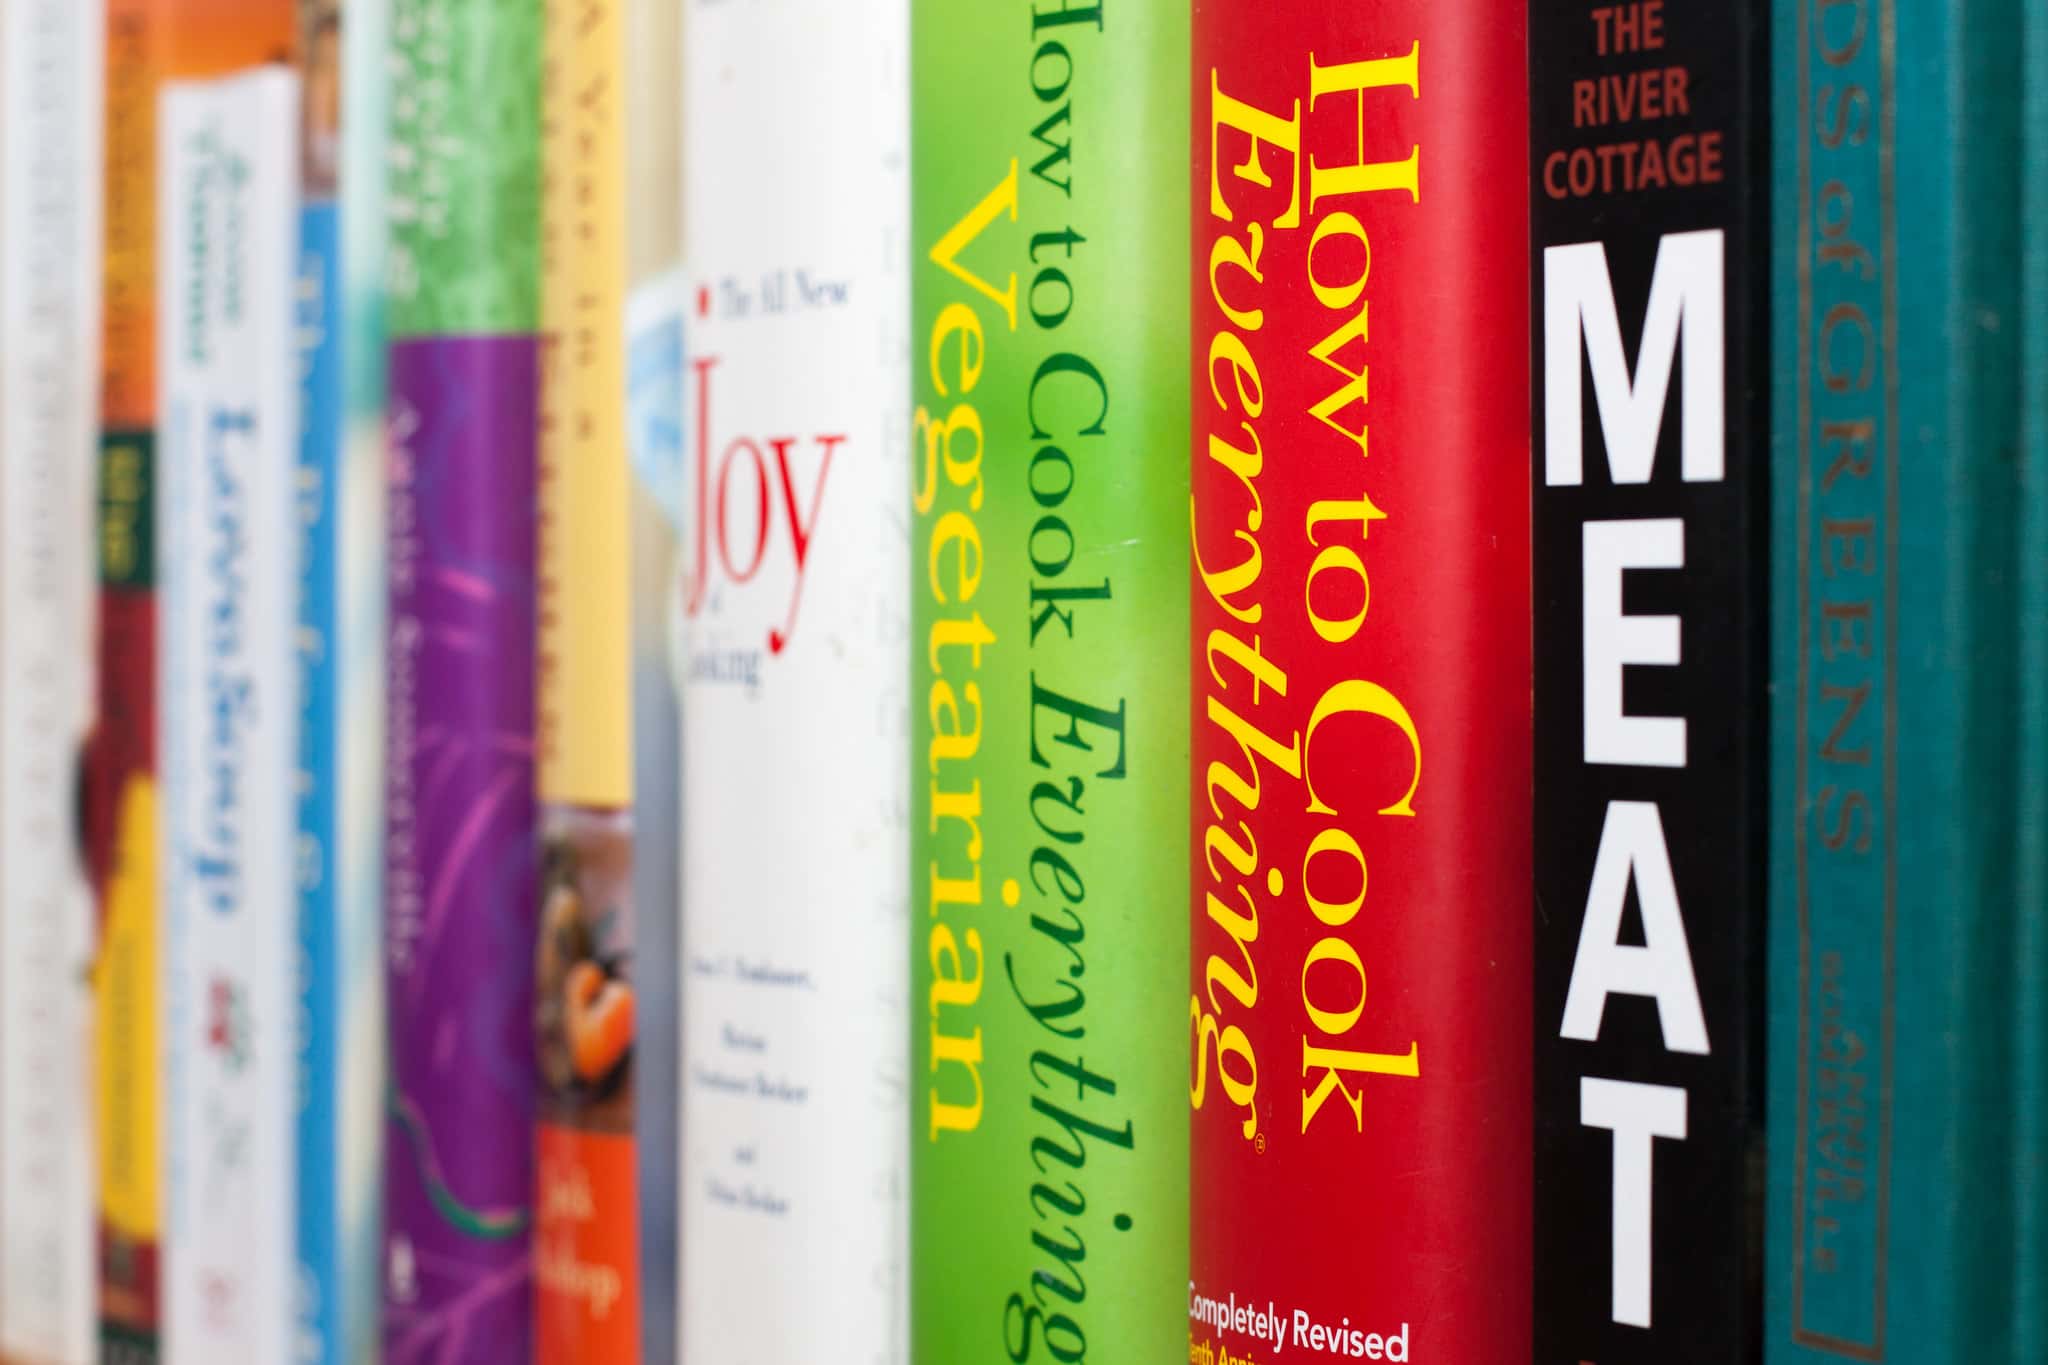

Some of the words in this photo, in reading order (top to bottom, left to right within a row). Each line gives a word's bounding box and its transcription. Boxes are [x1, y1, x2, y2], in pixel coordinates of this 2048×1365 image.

[1543, 131, 1723, 199] COTTAGE
[1573, 66, 1689, 127] RIVER
[1591, 0, 1664, 55] THE
[1029, 226, 1087, 330] to
[1307, 39, 1421, 458] How
[1816, 182, 1876, 282] of
[686, 354, 850, 656] Joy
[1028, 352, 1111, 647] Cook
[1190, 66, 1301, 1141] Everything
[1305, 490, 1388, 643] to
[1816, 302, 1878, 856] GREENS
[913, 158, 1022, 1142] Vegetarian
[1543, 229, 1726, 1328] MEAT
[1004, 670, 1135, 1365] Everything
[1301, 679, 1422, 1134] Cook
[1188, 1280, 1289, 1354] Completely
[1292, 1308, 1411, 1363] Revised
